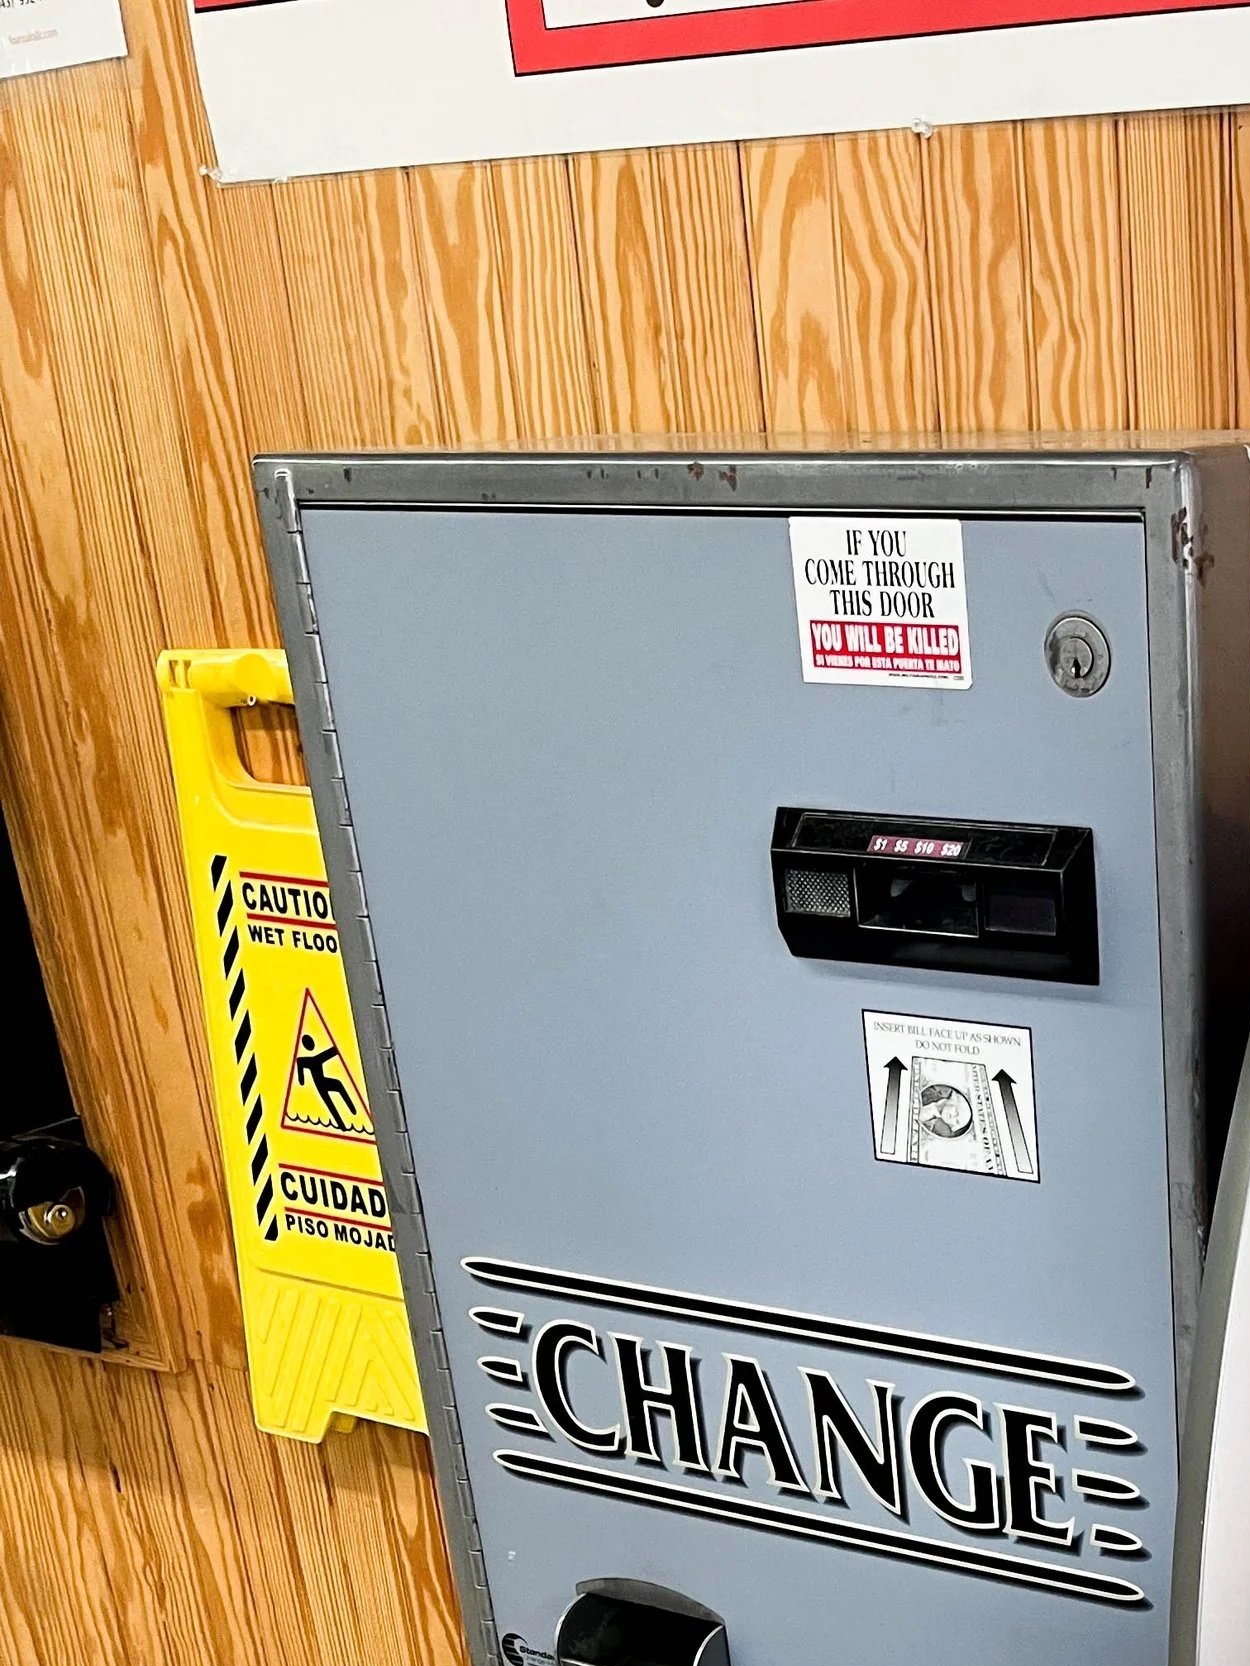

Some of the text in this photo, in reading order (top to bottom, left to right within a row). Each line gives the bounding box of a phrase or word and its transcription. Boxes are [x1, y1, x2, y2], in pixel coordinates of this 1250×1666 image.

[846, 529, 906, 557] IF YOU
[805, 558, 955, 588] COME THROUGH
[830, 589, 935, 618] THIS DOOR
[812, 623, 959, 655] YOU WILL BE KILLED
[815, 654, 960, 672] SI VIENES POR ESTA PUERTA TE MATO
[873, 838, 961, 857] $1 $5 $10 $20
[242, 882, 328, 920] CAUTIO
[248, 924, 338, 953] WET FLOO
[873, 1021, 1022, 1047] INSERT BILL FACE UP AS SHOWN
[915, 1039, 980, 1055] DO NOT FOLD
[280, 1171, 386, 1218] CUIDAD
[285, 1213, 396, 1251] PISO MOJAD
[532, 1319, 1080, 1550] CHANGE
